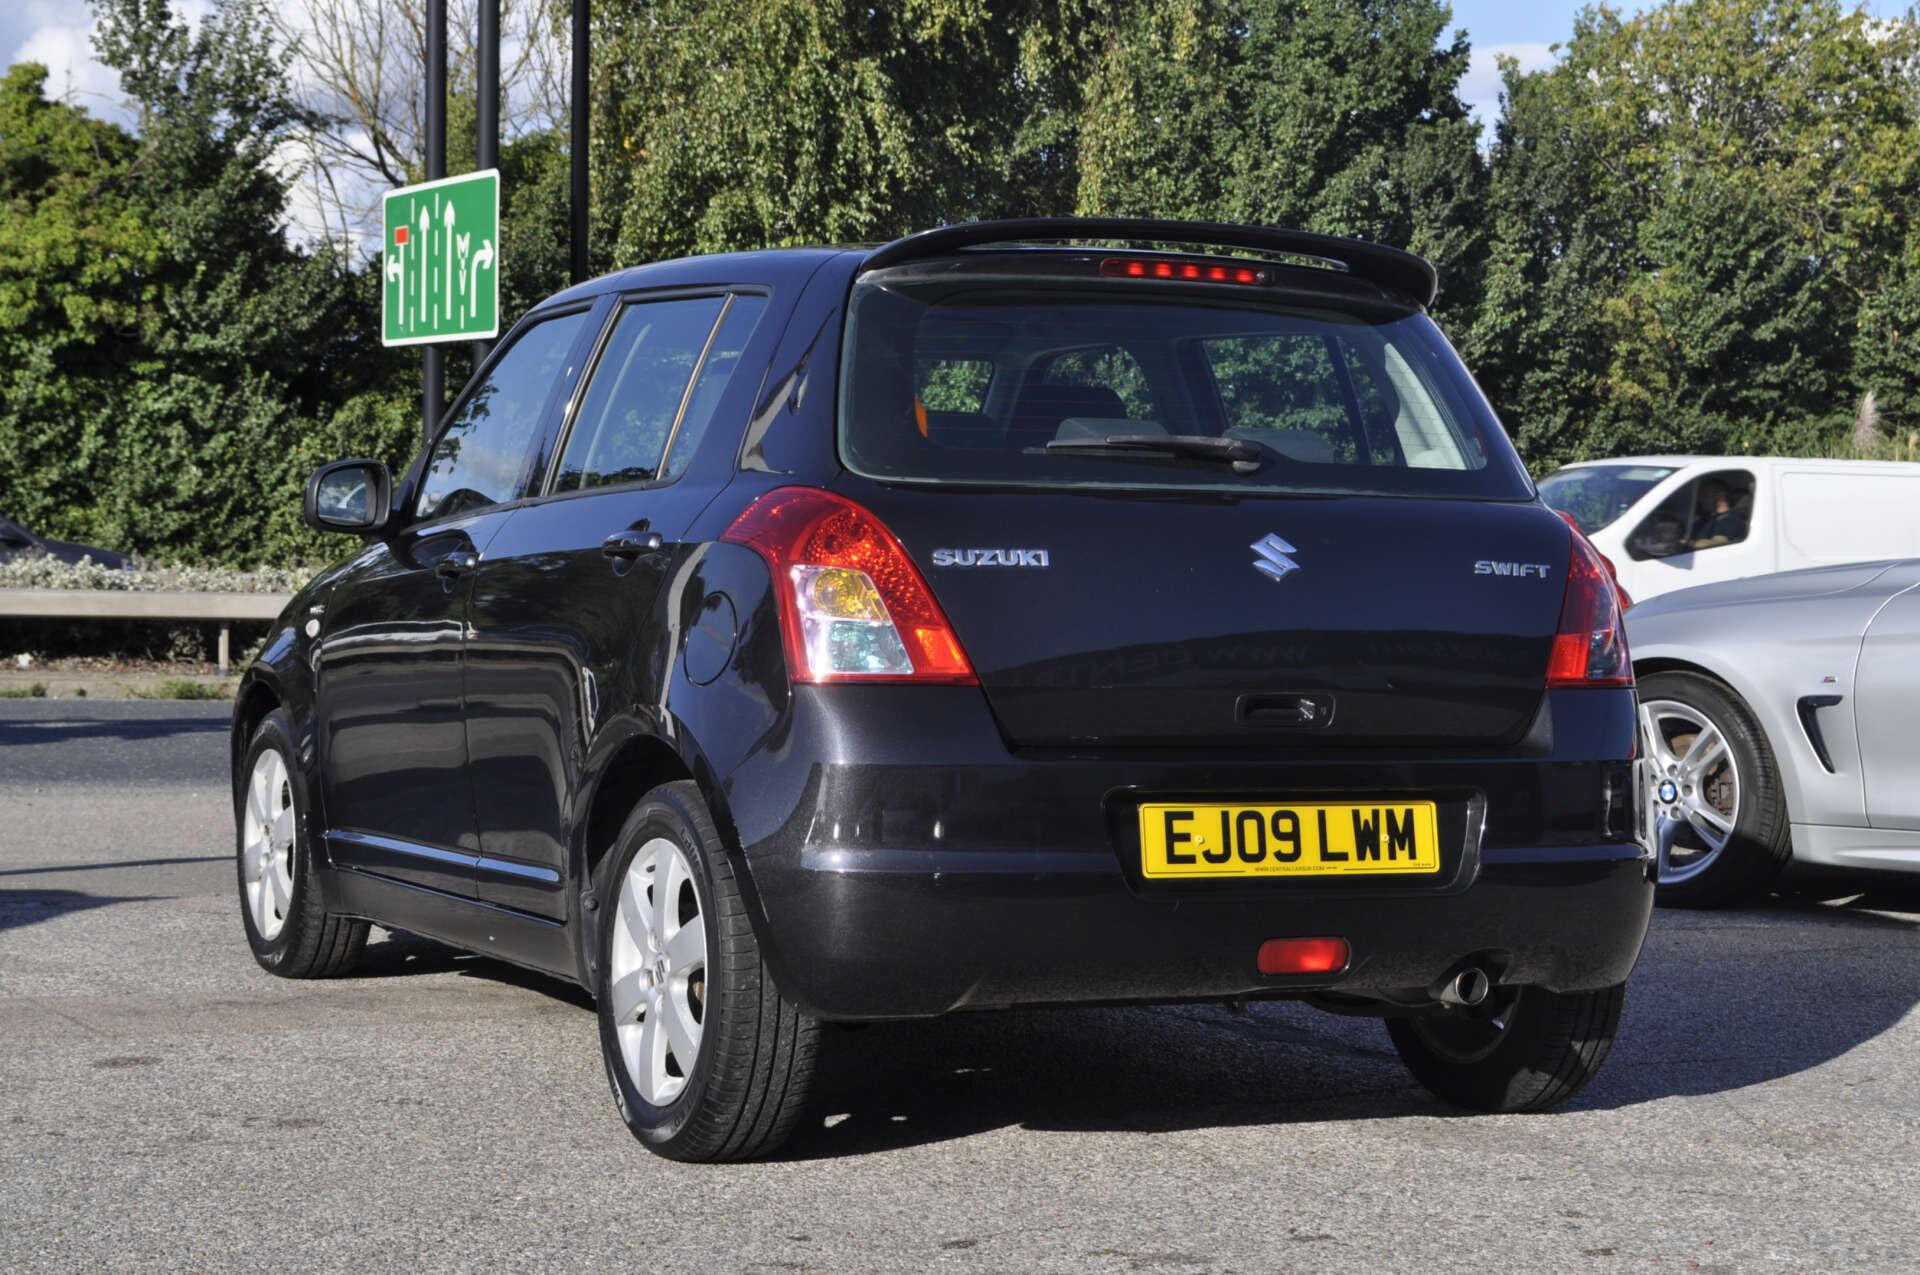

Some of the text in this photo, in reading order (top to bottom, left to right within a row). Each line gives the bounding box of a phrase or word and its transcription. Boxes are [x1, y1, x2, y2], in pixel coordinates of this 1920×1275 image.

[932, 548, 1050, 567] SUZUKI
[1474, 560, 1551, 578] SWIFT
[1164, 808, 1418, 865] EJ09 LWM
